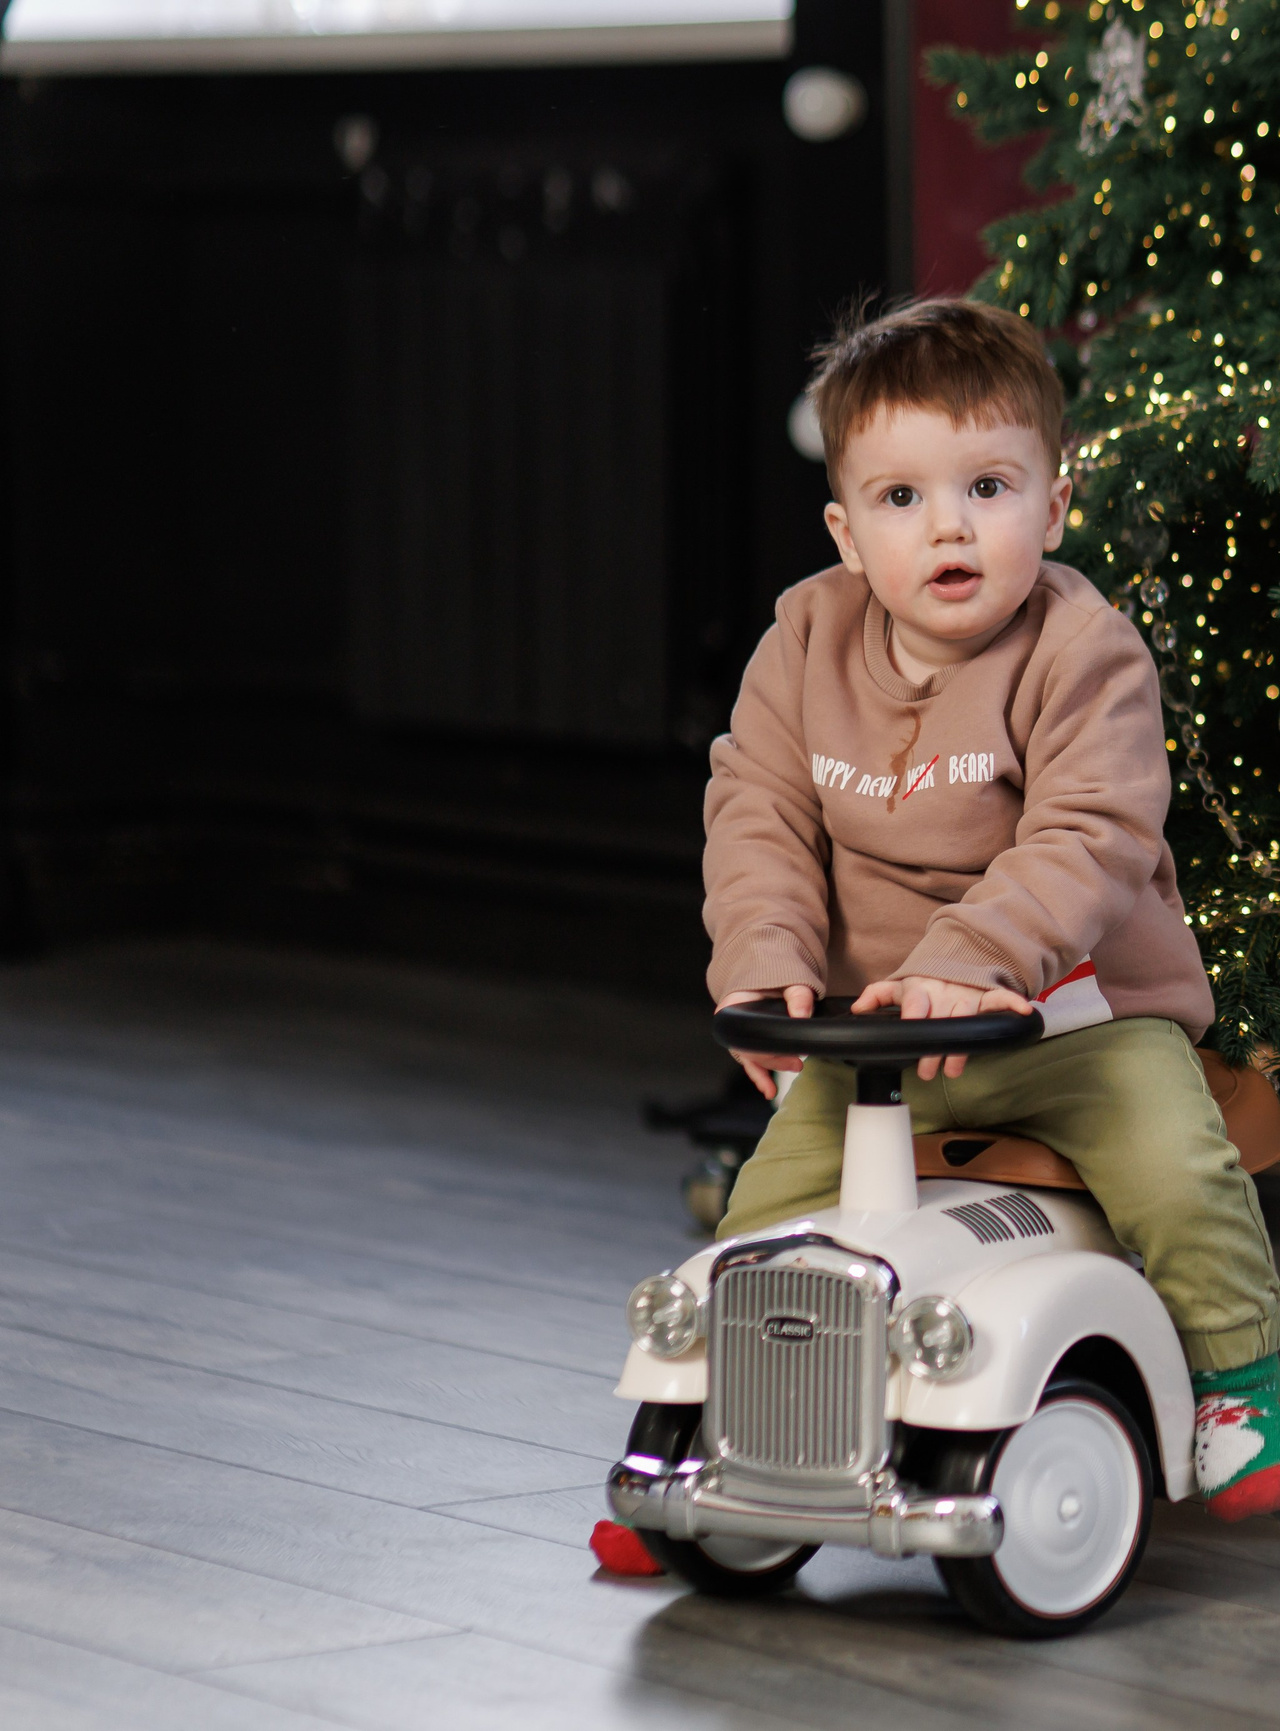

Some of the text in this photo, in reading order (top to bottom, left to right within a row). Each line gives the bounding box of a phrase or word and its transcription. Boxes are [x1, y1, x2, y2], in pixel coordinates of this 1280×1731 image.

[812, 753, 857, 790] HAPPY
[906, 762, 935, 793] YEAR
[949, 752, 995, 785] BEAR!
[766, 1320, 812, 1338] CLASSIC
